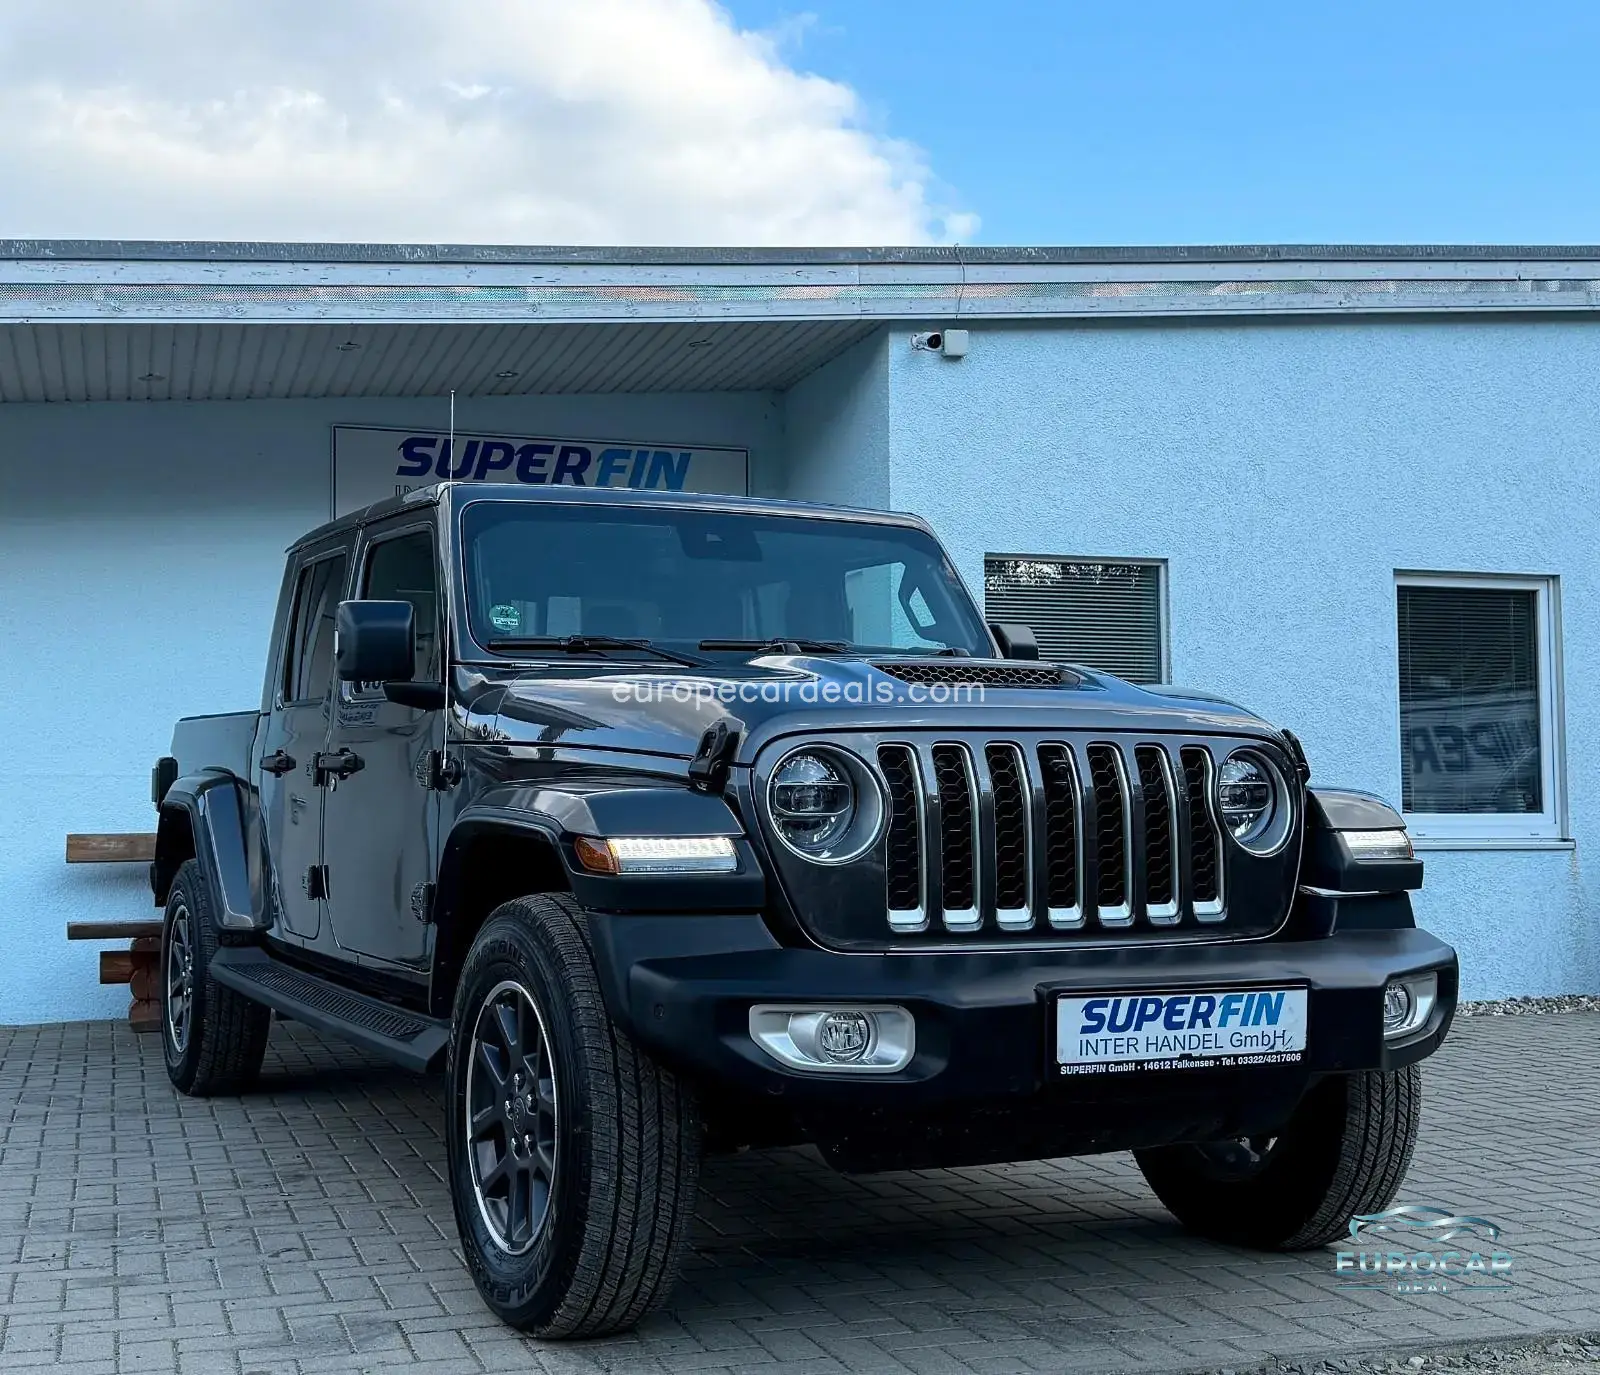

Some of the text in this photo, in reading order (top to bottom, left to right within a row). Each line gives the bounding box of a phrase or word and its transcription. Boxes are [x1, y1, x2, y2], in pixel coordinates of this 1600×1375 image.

[395, 436, 692, 492] SUPERFIN
[1079, 992, 1286, 1035] SUPERFIN
[1079, 1029, 1287, 1057] INTER HANDEL GmbH
[1060, 1064, 1106, 1075] SUPERFIN
[1108, 1062, 1136, 1073] GmbH
[1143, 1060, 1171, 1071] 14612
[1172, 1059, 1215, 1069] Falkensee
[1221, 1057, 1236, 1066] Tel.
